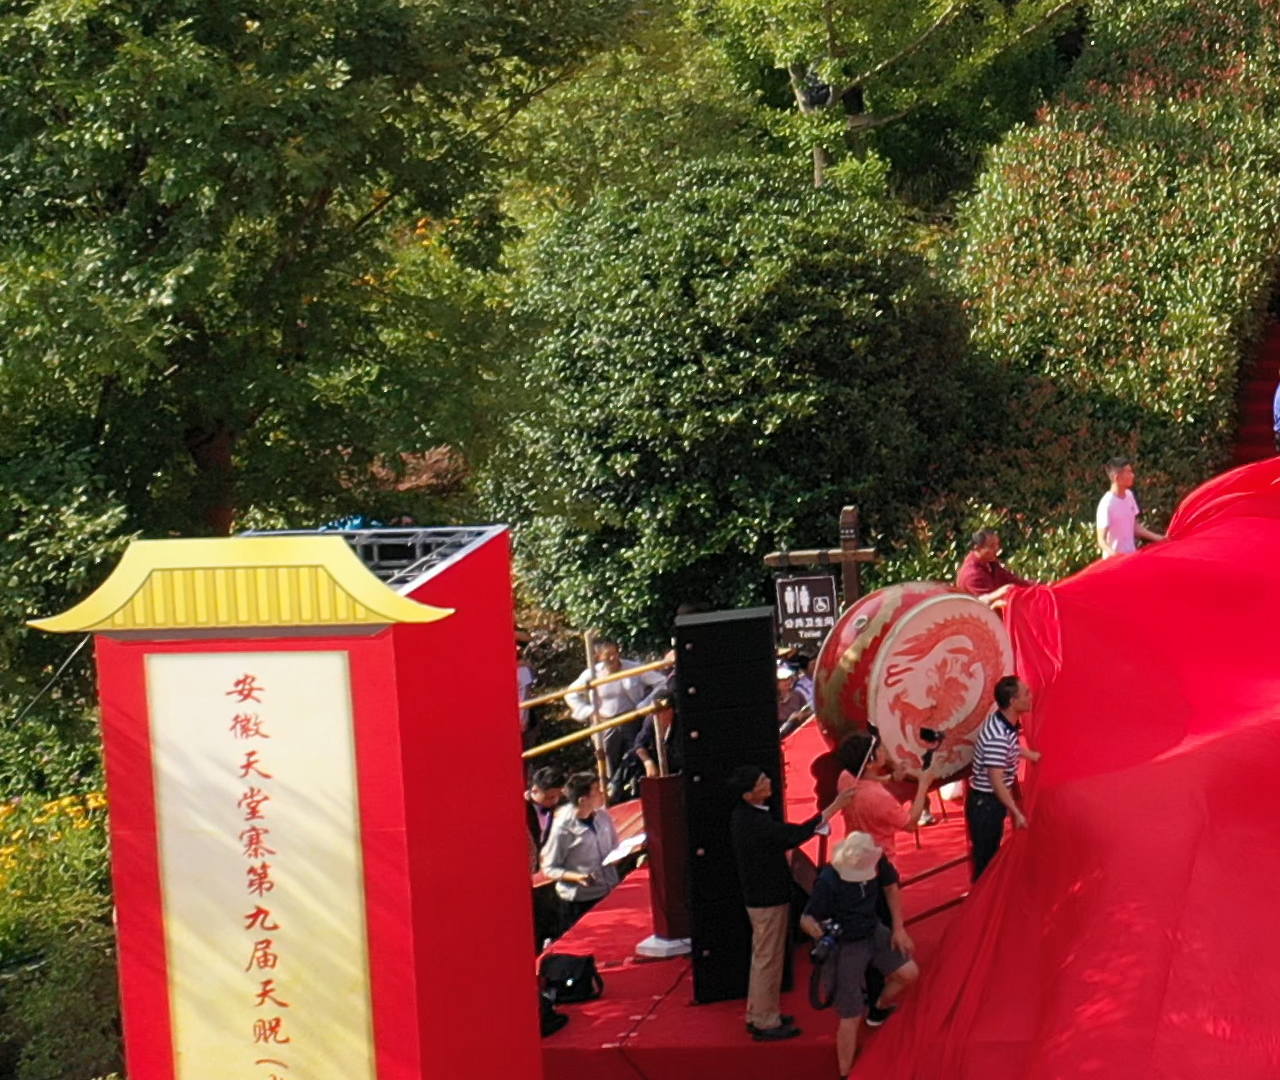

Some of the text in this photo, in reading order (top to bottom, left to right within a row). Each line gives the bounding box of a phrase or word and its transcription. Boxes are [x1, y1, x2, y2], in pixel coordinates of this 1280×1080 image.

[225, 673, 290, 1080] 安徽天堂寨第九届天贶（
